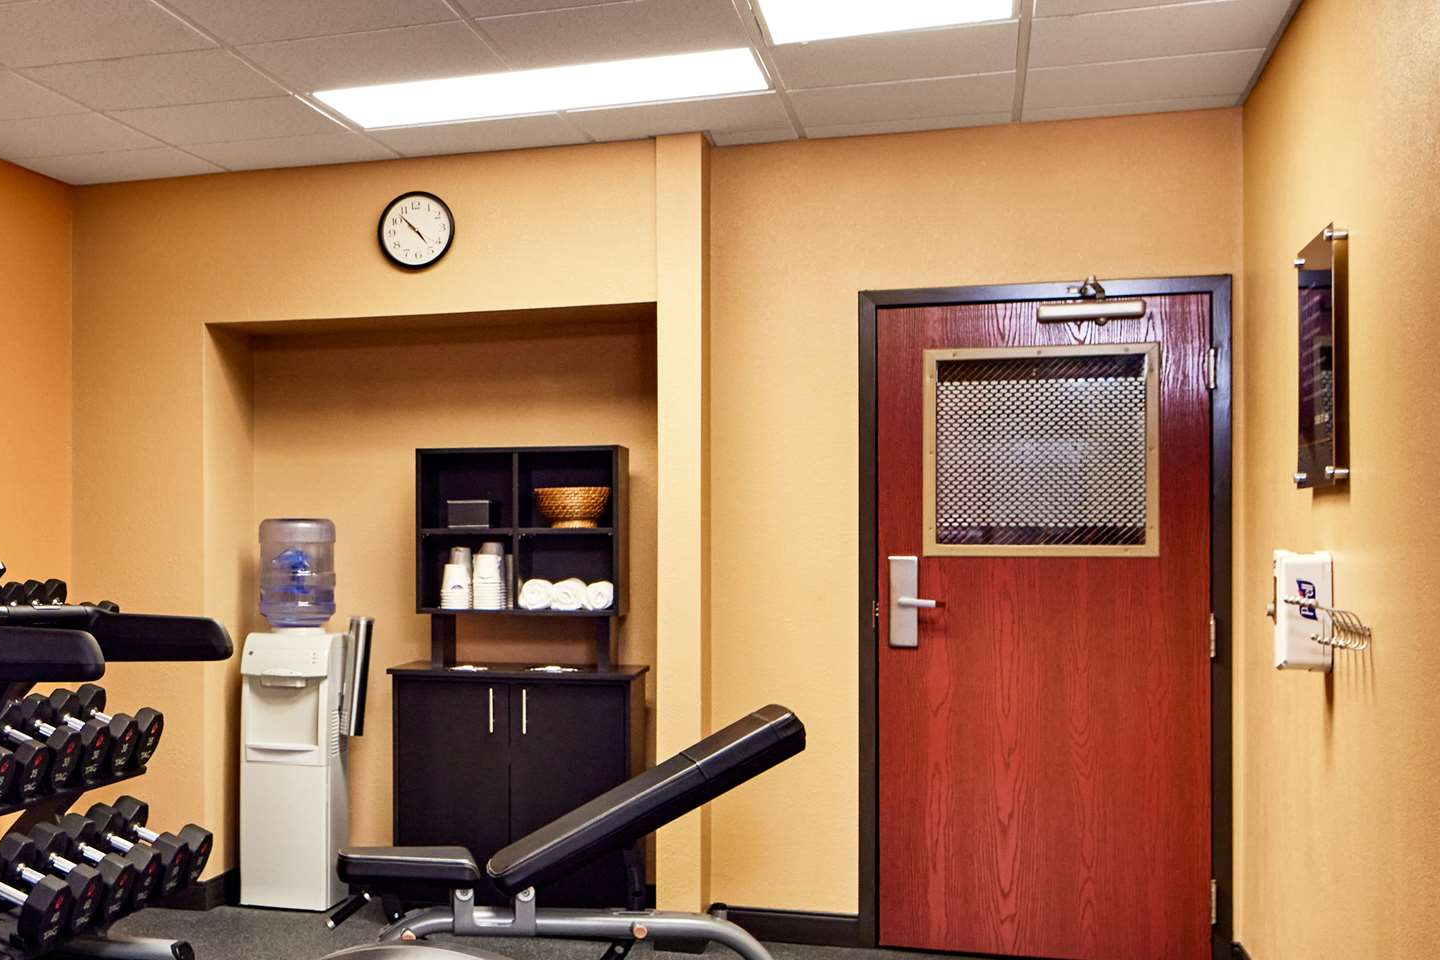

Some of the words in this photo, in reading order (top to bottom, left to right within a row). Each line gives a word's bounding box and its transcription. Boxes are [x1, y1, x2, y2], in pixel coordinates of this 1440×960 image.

[400, 206, 408, 215] 11
[411, 201, 421, 211] 12
[434, 211, 441, 220] 2
[392, 218, 403, 226] 10
[440, 224, 446, 232] 3
[388, 229, 396, 237] 9
[393, 241, 401, 249] 8
[403, 248, 410, 257] 7
[414, 247, 423, 259] 6
